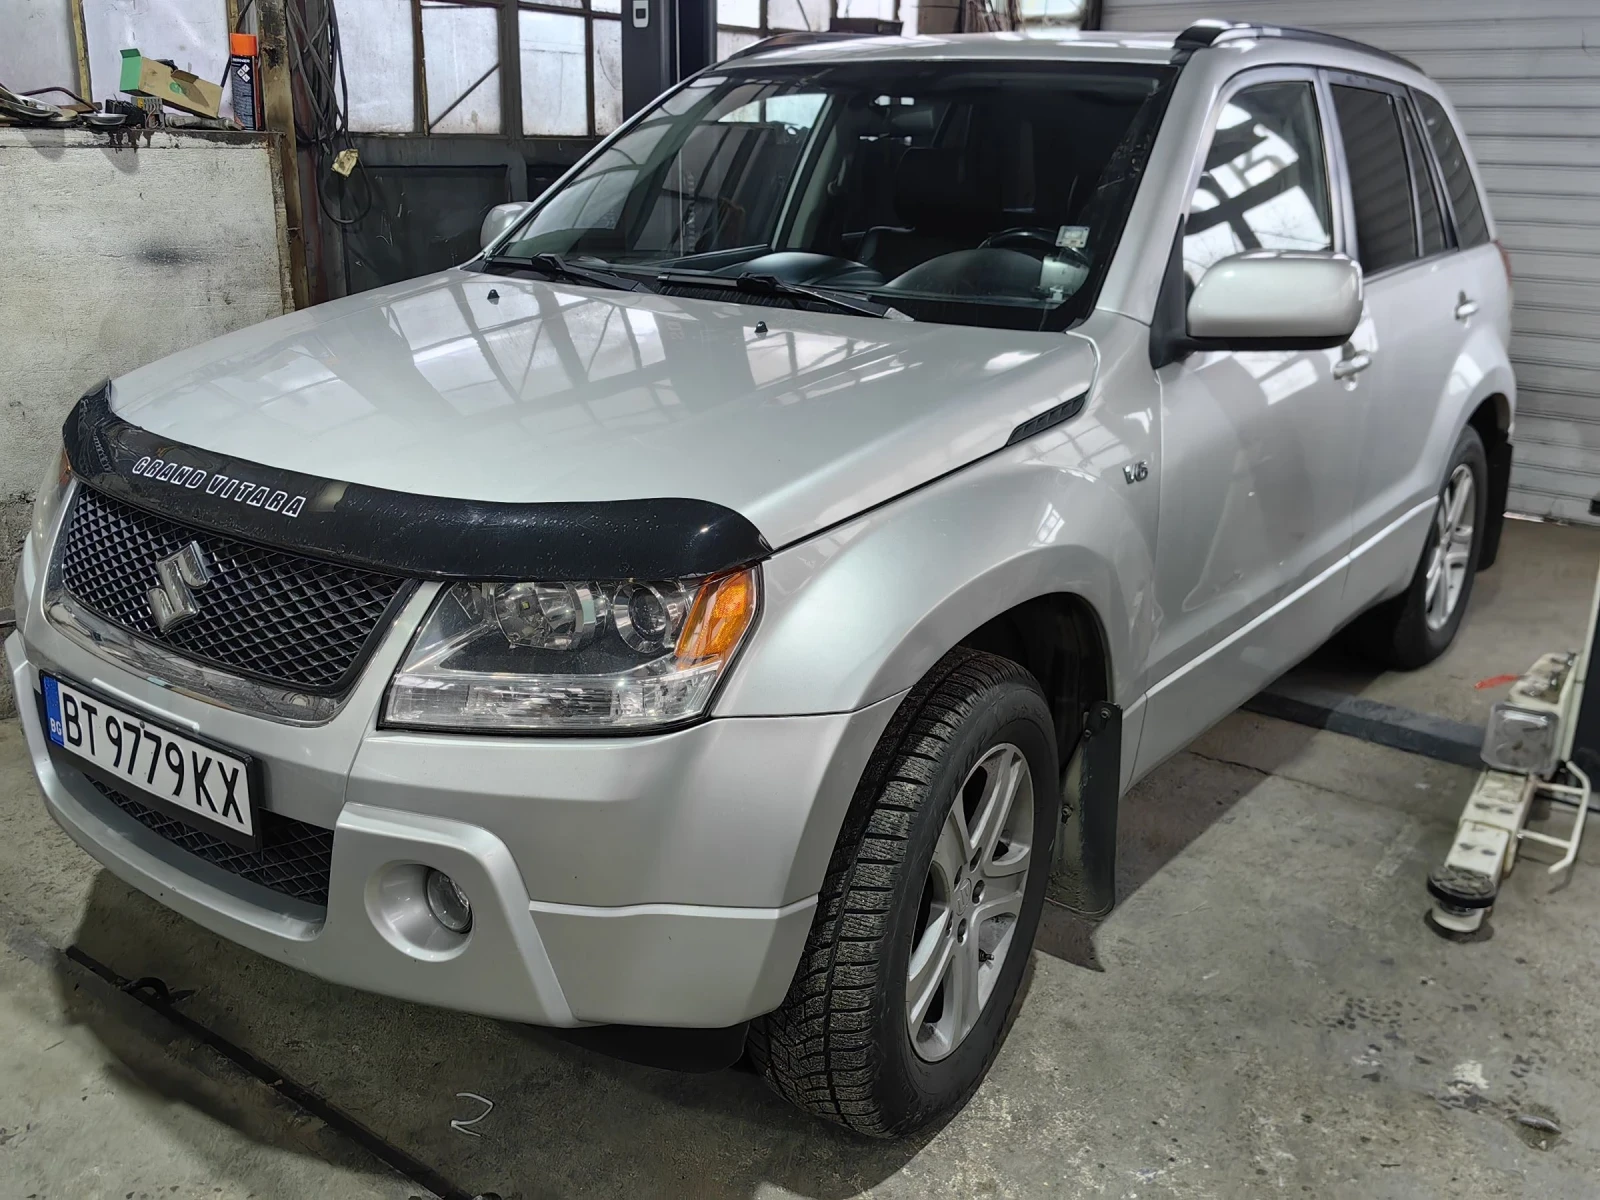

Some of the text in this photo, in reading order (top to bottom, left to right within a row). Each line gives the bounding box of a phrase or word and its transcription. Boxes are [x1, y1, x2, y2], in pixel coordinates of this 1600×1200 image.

[132, 456, 307, 518] GRAND VITARA
[1121, 460, 1149, 485] V6
[49, 717, 63, 737] BG
[62, 691, 245, 825] BT 9779 KX
